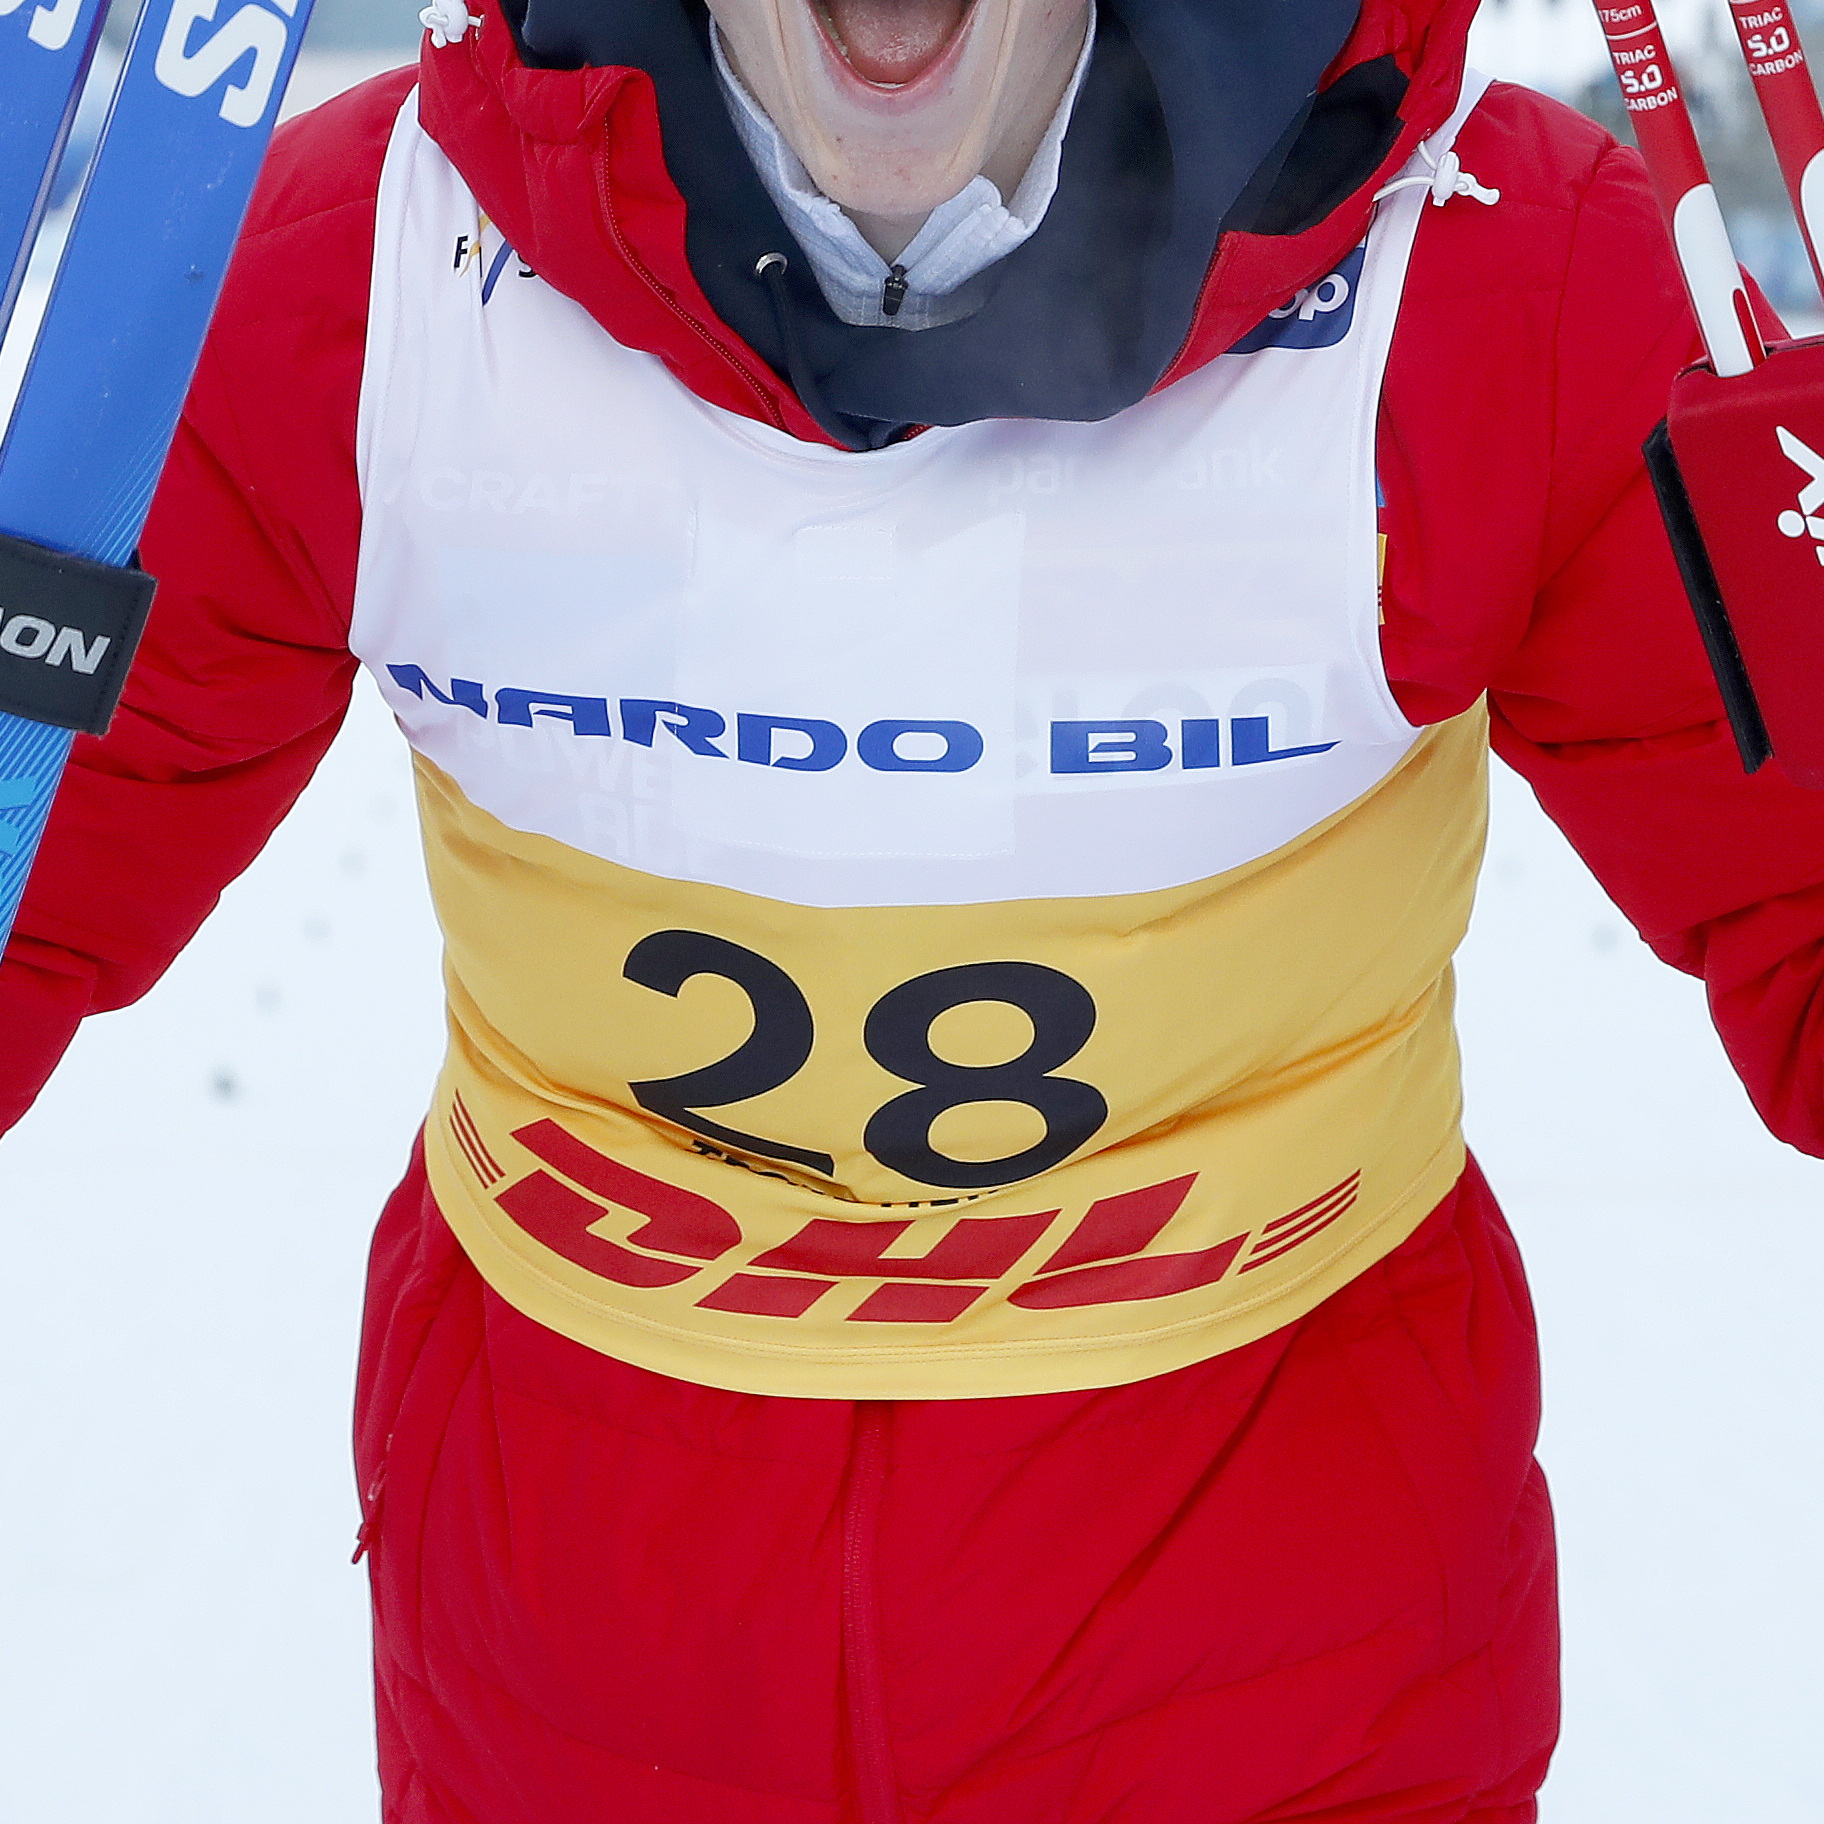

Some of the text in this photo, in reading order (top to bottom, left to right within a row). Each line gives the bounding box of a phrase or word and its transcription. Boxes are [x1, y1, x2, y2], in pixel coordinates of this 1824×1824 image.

[1739, 7, 1783, 30] TRIAC
[1613, 44, 1657, 66] TRIAC
[1747, 26, 1790, 58] 5.0
[1621, 63, 1663, 93] 5.0
[1749, 50, 1804, 76] CARBON
[385, 663, 984, 774] NARDO
[1050, 715, 1343, 775] BIL
[622, 928, 1109, 1191] 28
[494, 1118, 1250, 1324] DHL
